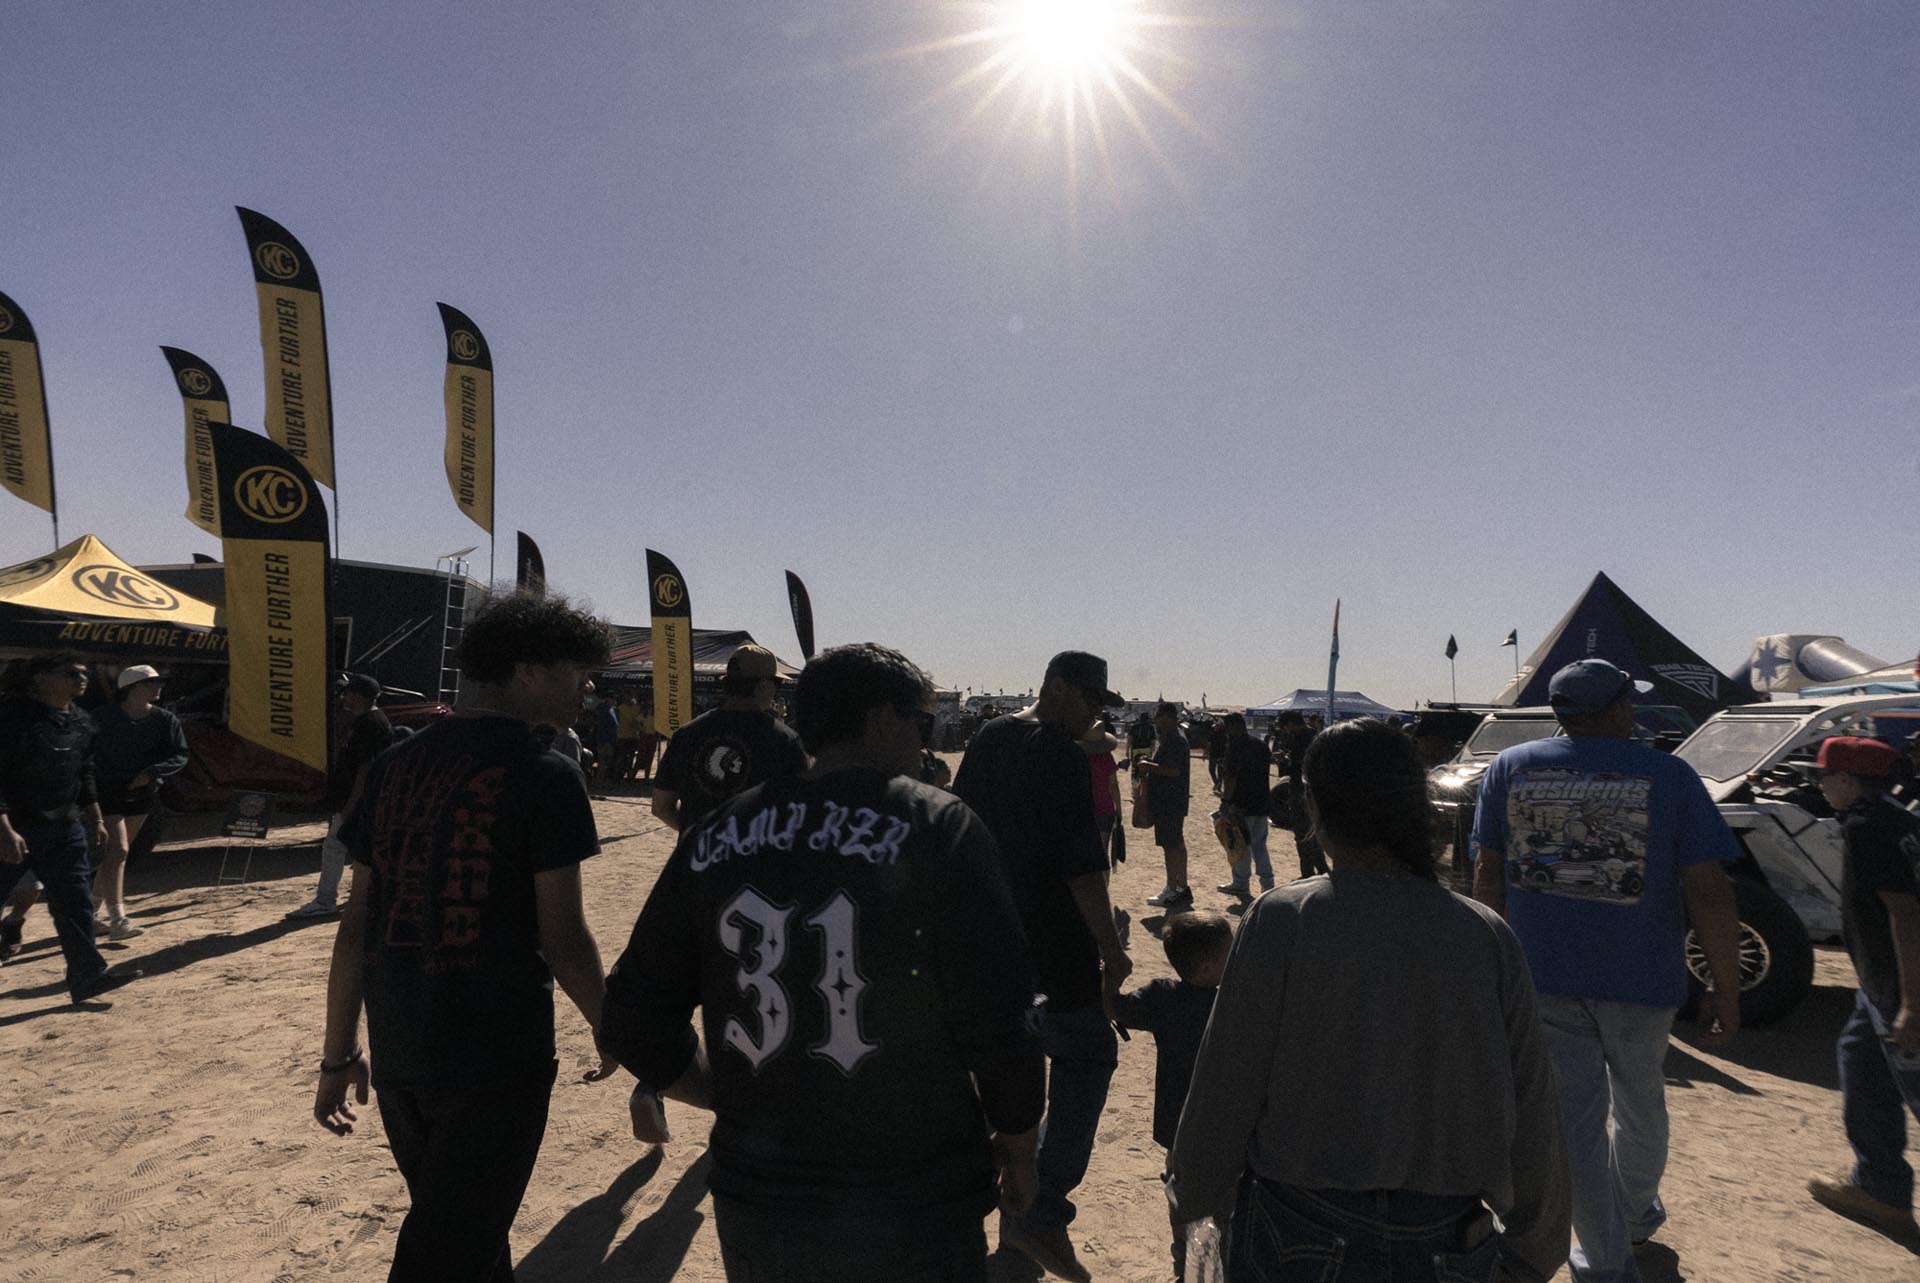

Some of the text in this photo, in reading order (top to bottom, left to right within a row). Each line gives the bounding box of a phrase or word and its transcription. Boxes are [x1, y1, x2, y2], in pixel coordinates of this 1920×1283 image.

[276, 297, 308, 459] ADVENTURE FURTHER
[0, 412, 25, 486] ADVENTURE
[192, 407, 216, 524] ADVENTURE FURTHER
[460, 375, 477, 507] ADVENTURE FURTHER
[246, 471, 296, 516] KC
[87, 571, 166, 606] KC
[59, 623, 229, 651] ADVENTURE FURT
[265, 552, 294, 738] ADVENTURE FURTHER
[667, 672, 679, 730] ADVENTURE
[718, 884, 881, 1077] 31
